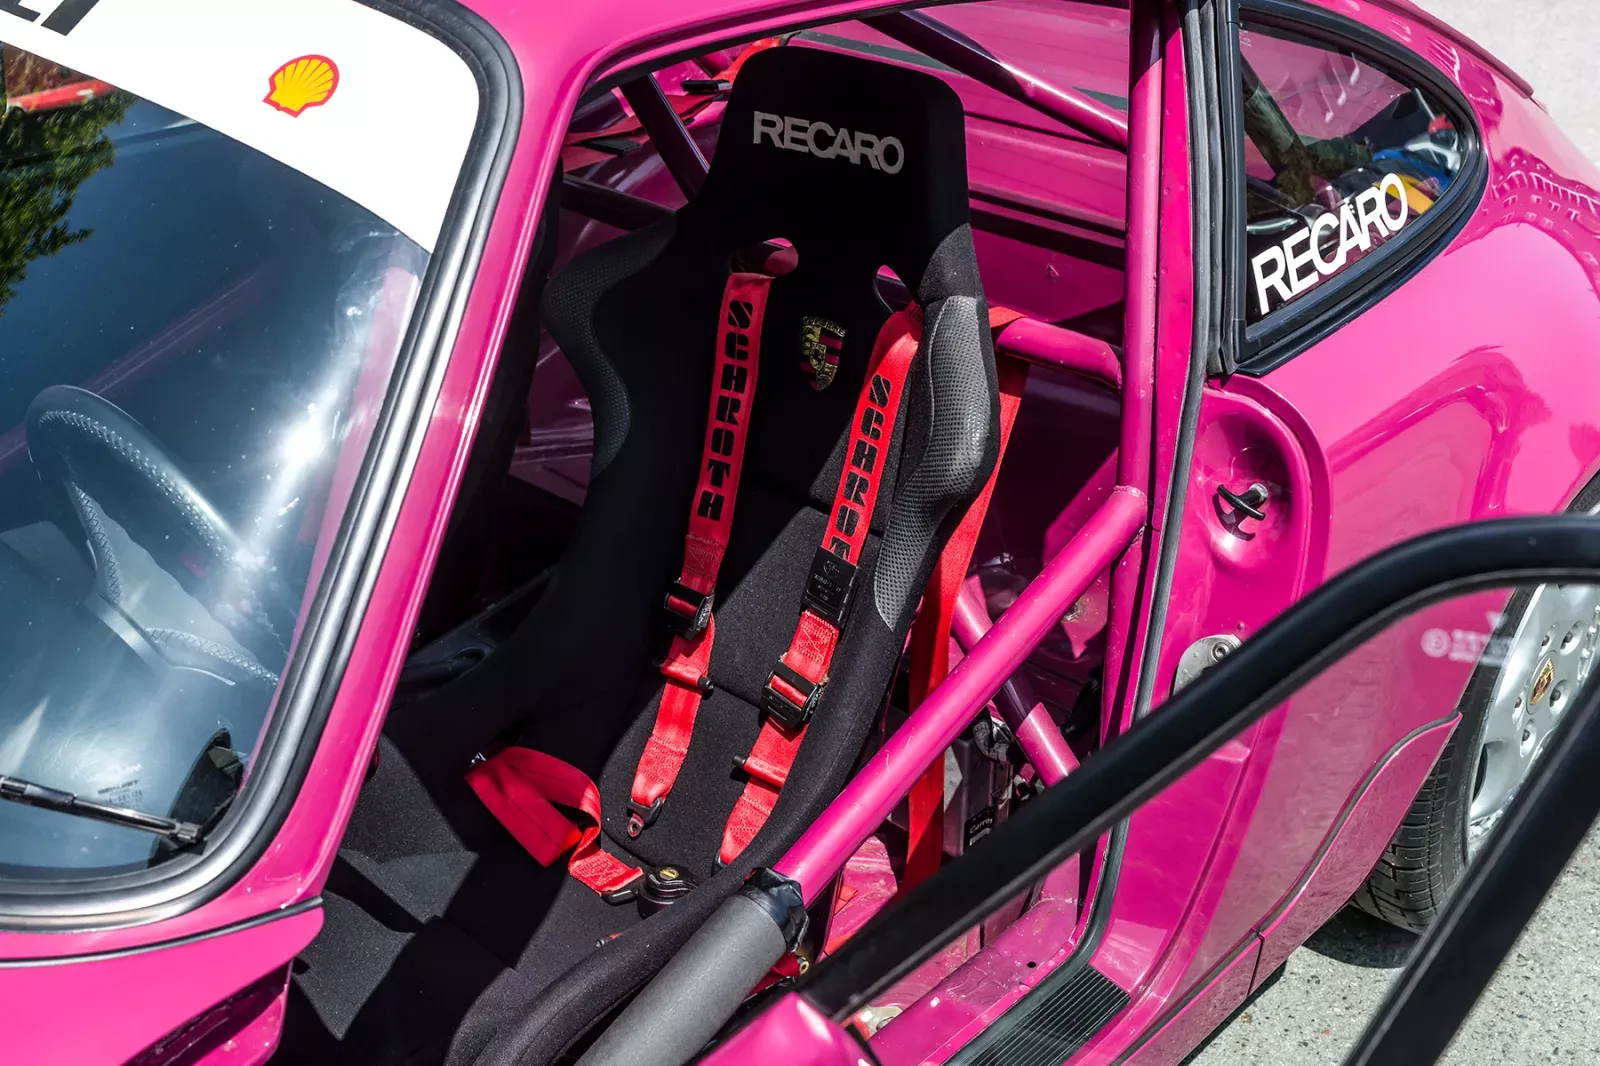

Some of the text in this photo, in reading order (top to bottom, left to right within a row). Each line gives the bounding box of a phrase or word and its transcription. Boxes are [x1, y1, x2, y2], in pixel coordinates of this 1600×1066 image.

[753, 110, 905, 174] RECARO
[1251, 172, 1408, 316] RECARO
[697, 300, 753, 521] SCHROTH
